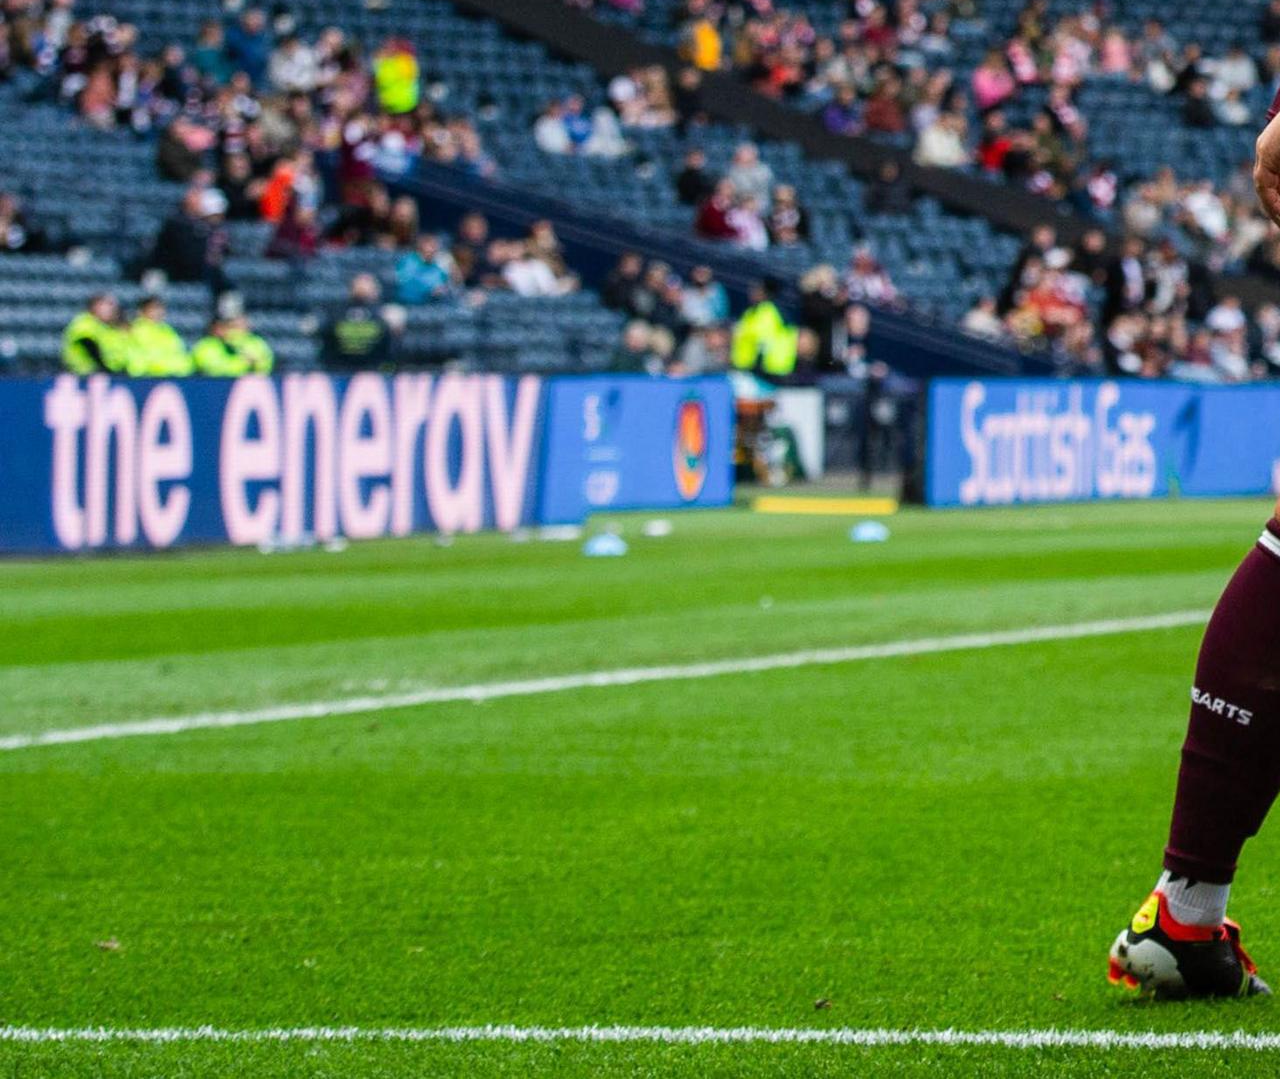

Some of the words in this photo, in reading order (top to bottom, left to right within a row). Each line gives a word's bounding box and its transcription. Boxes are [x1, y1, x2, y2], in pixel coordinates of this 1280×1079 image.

[44, 372, 193, 550] the
[961, 381, 1091, 505] Scottish
[1094, 381, 1156, 498] Gas
[1191, 686, 1253, 725] EARTS
